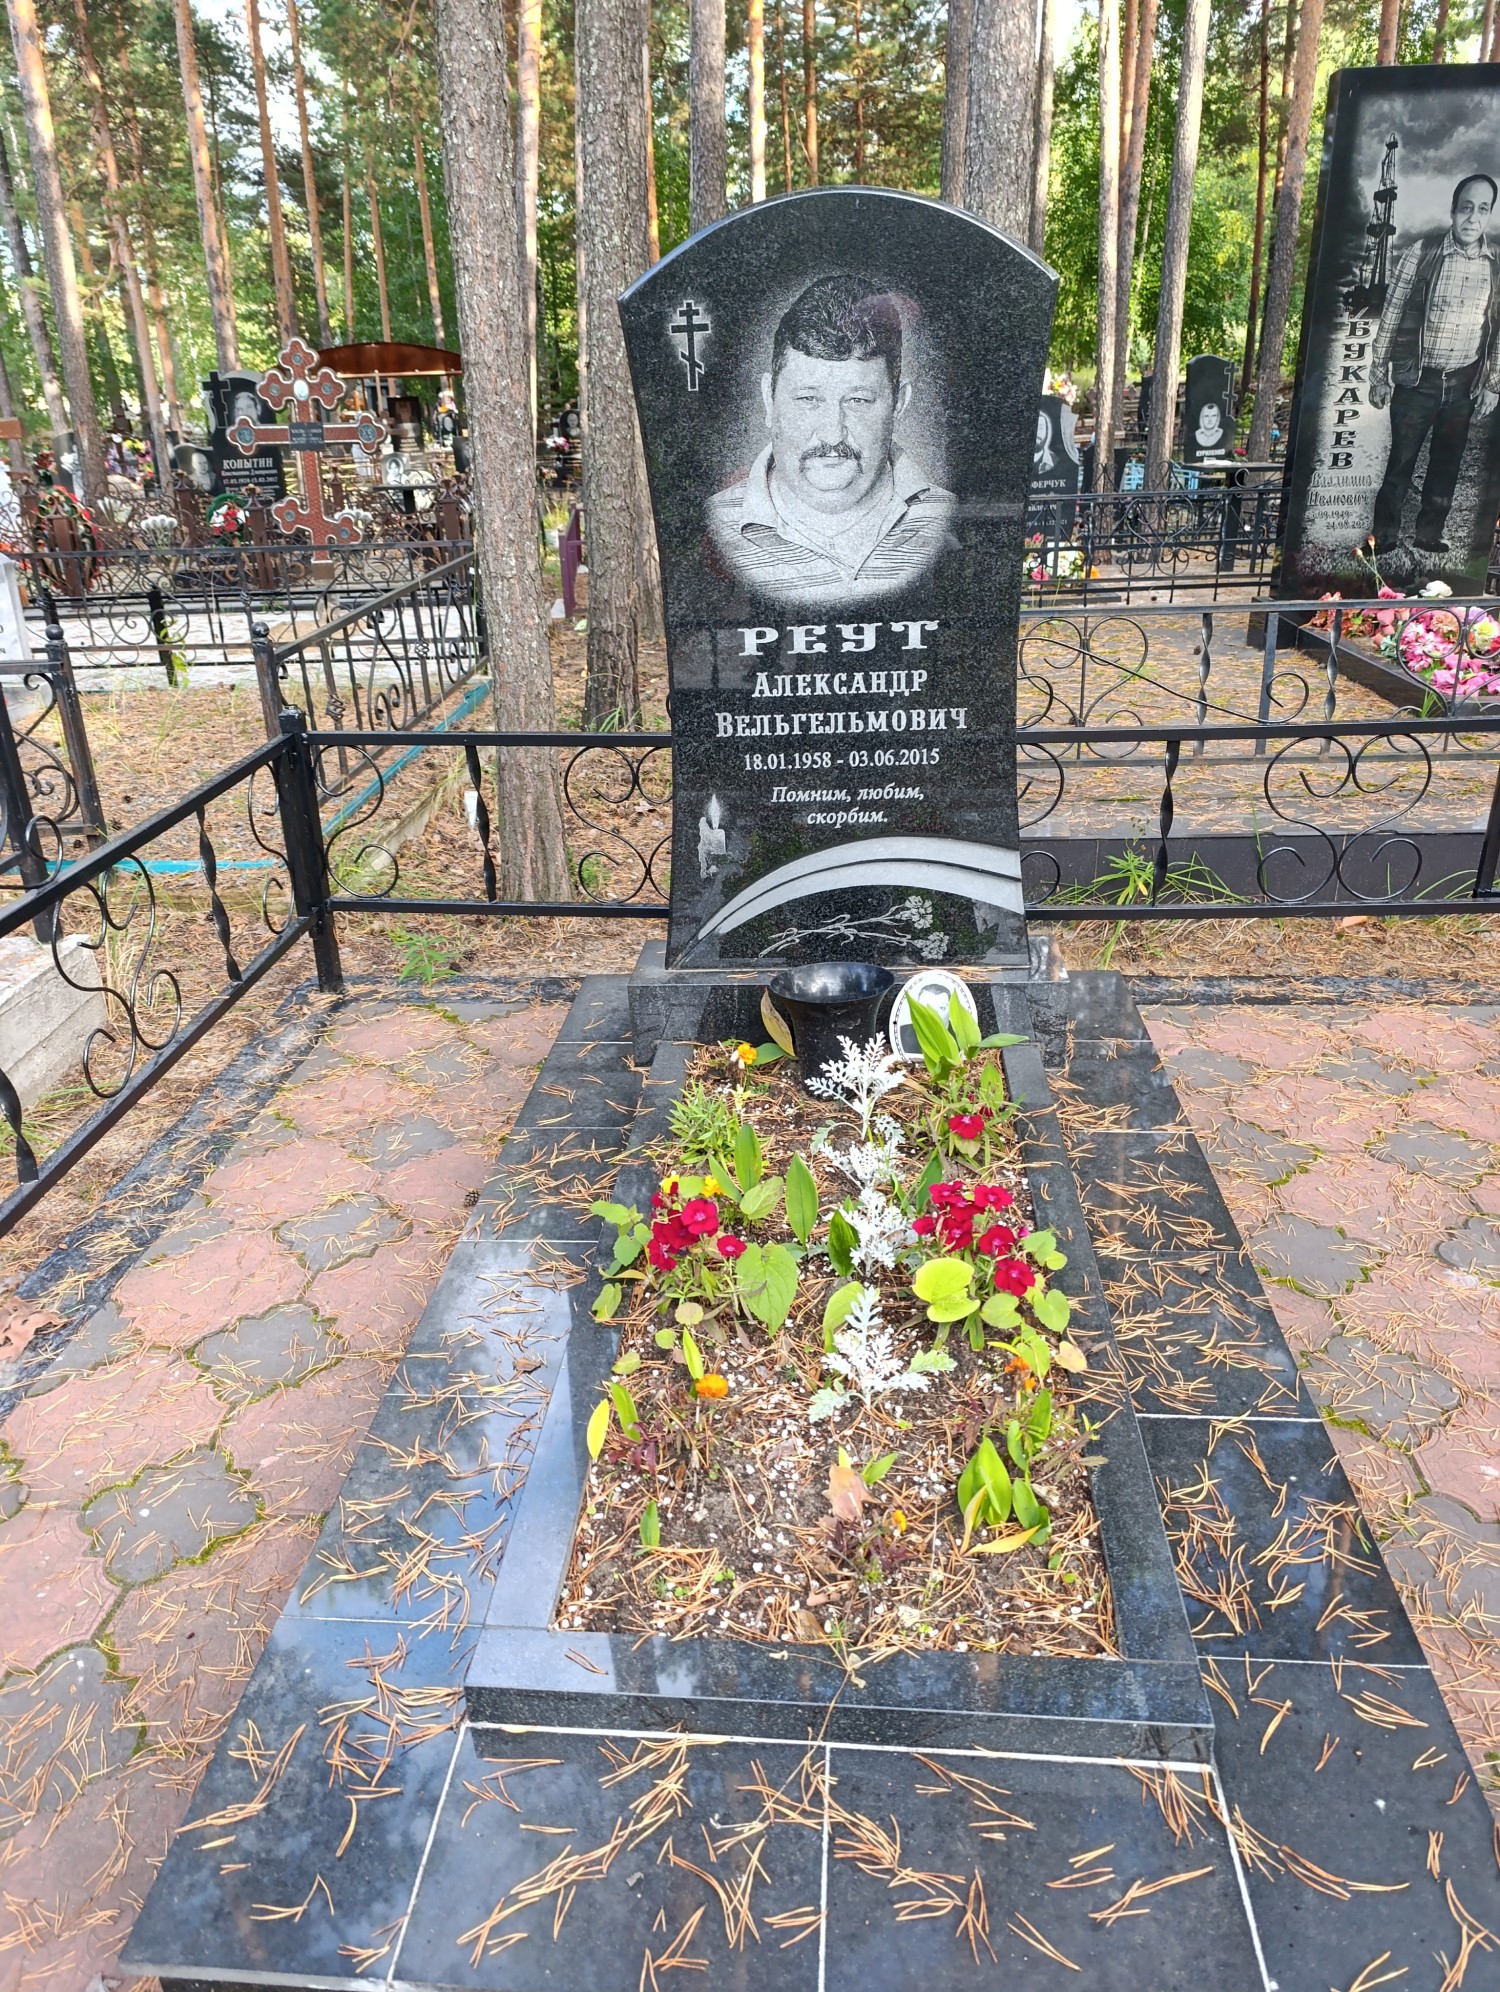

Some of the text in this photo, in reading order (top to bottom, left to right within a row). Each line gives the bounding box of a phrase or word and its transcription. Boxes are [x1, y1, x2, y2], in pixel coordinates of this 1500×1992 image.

[1327, 319, 1373, 470] БУКАРЕВ
[223, 458, 273, 470] КОПЫТИН
[737, 620, 940, 657] РЕУТ
[751, 669, 928, 698] АЛЕКСАНДР
[714, 708, 968, 737] ВЕЛЬГЕЛЬМОВИЧ
[744, 752, 832, 770] 18.01.1958
[849, 748, 940, 767] 03.06.2015
[770, 782, 924, 803] Помним, любим,
[806, 807, 888, 828] скорбим.
